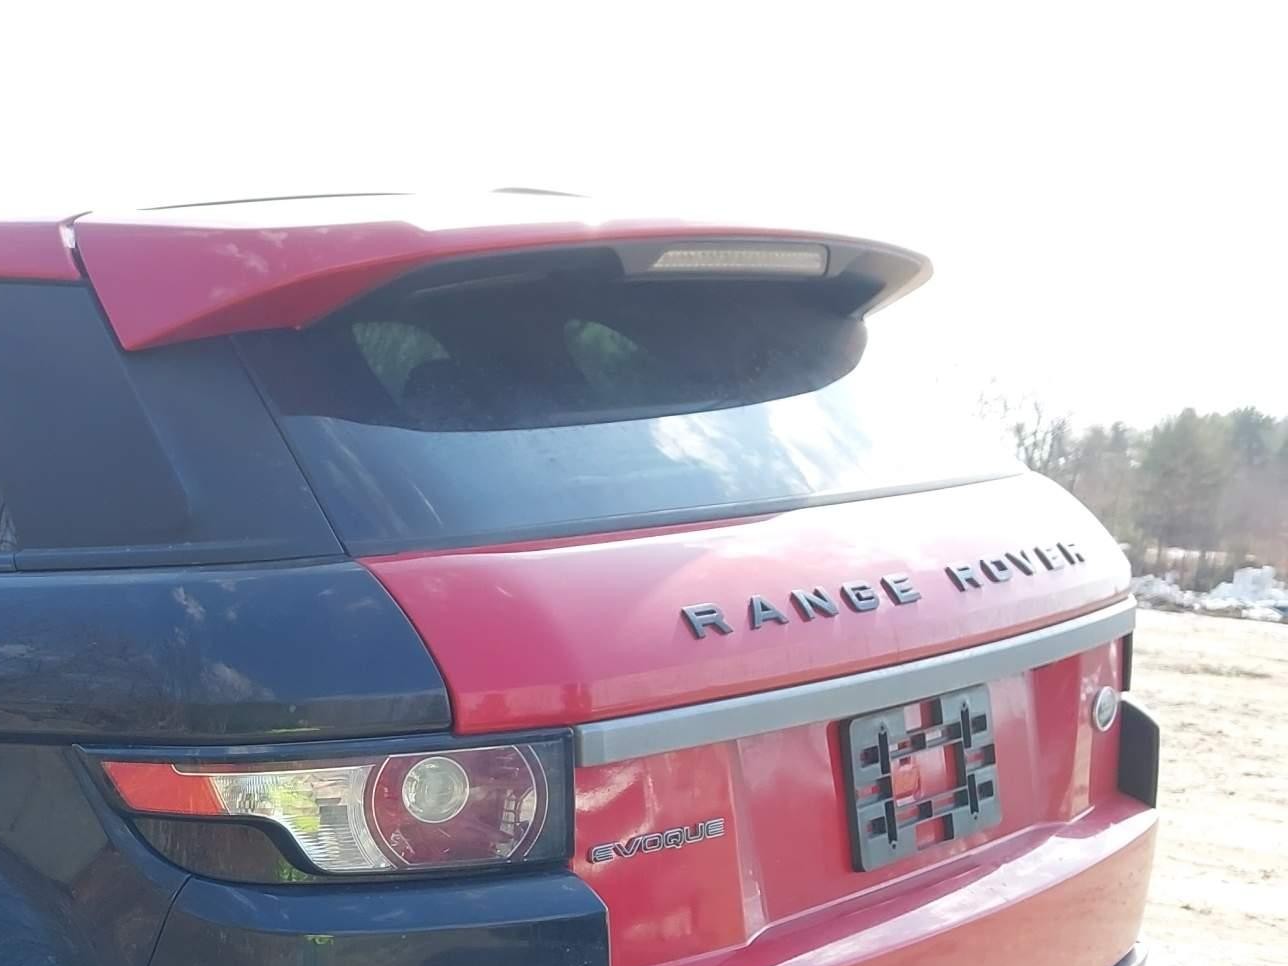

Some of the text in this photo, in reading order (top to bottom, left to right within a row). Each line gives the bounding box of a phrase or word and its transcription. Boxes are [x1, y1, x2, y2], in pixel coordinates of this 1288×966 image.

[680, 542, 1086, 639] RANGE ROVER
[587, 817, 725, 864] EVOQUE
